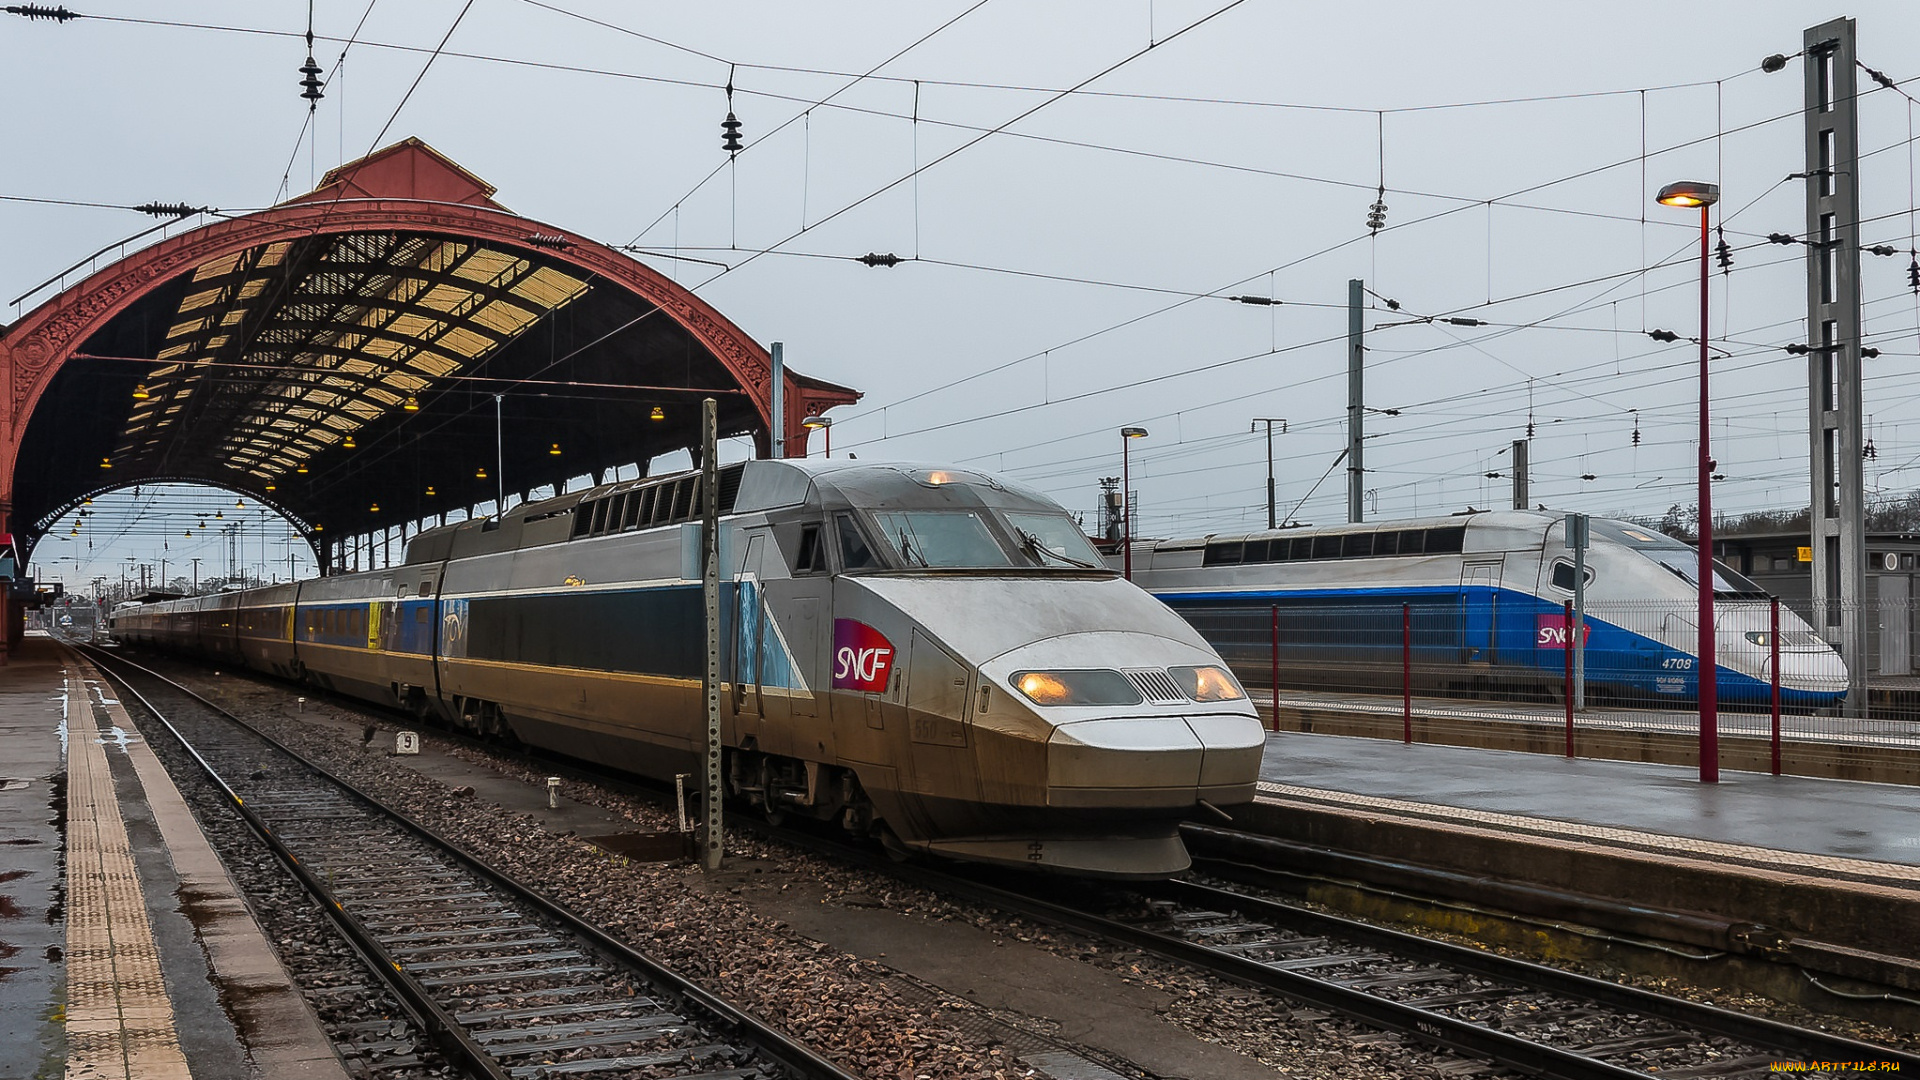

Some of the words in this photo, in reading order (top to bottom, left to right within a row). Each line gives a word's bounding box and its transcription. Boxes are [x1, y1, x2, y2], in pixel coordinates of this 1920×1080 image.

[835, 646, 891, 682] SNCF
[1662, 658, 1692, 669] 4708
[404, 735, 412, 748] 9
